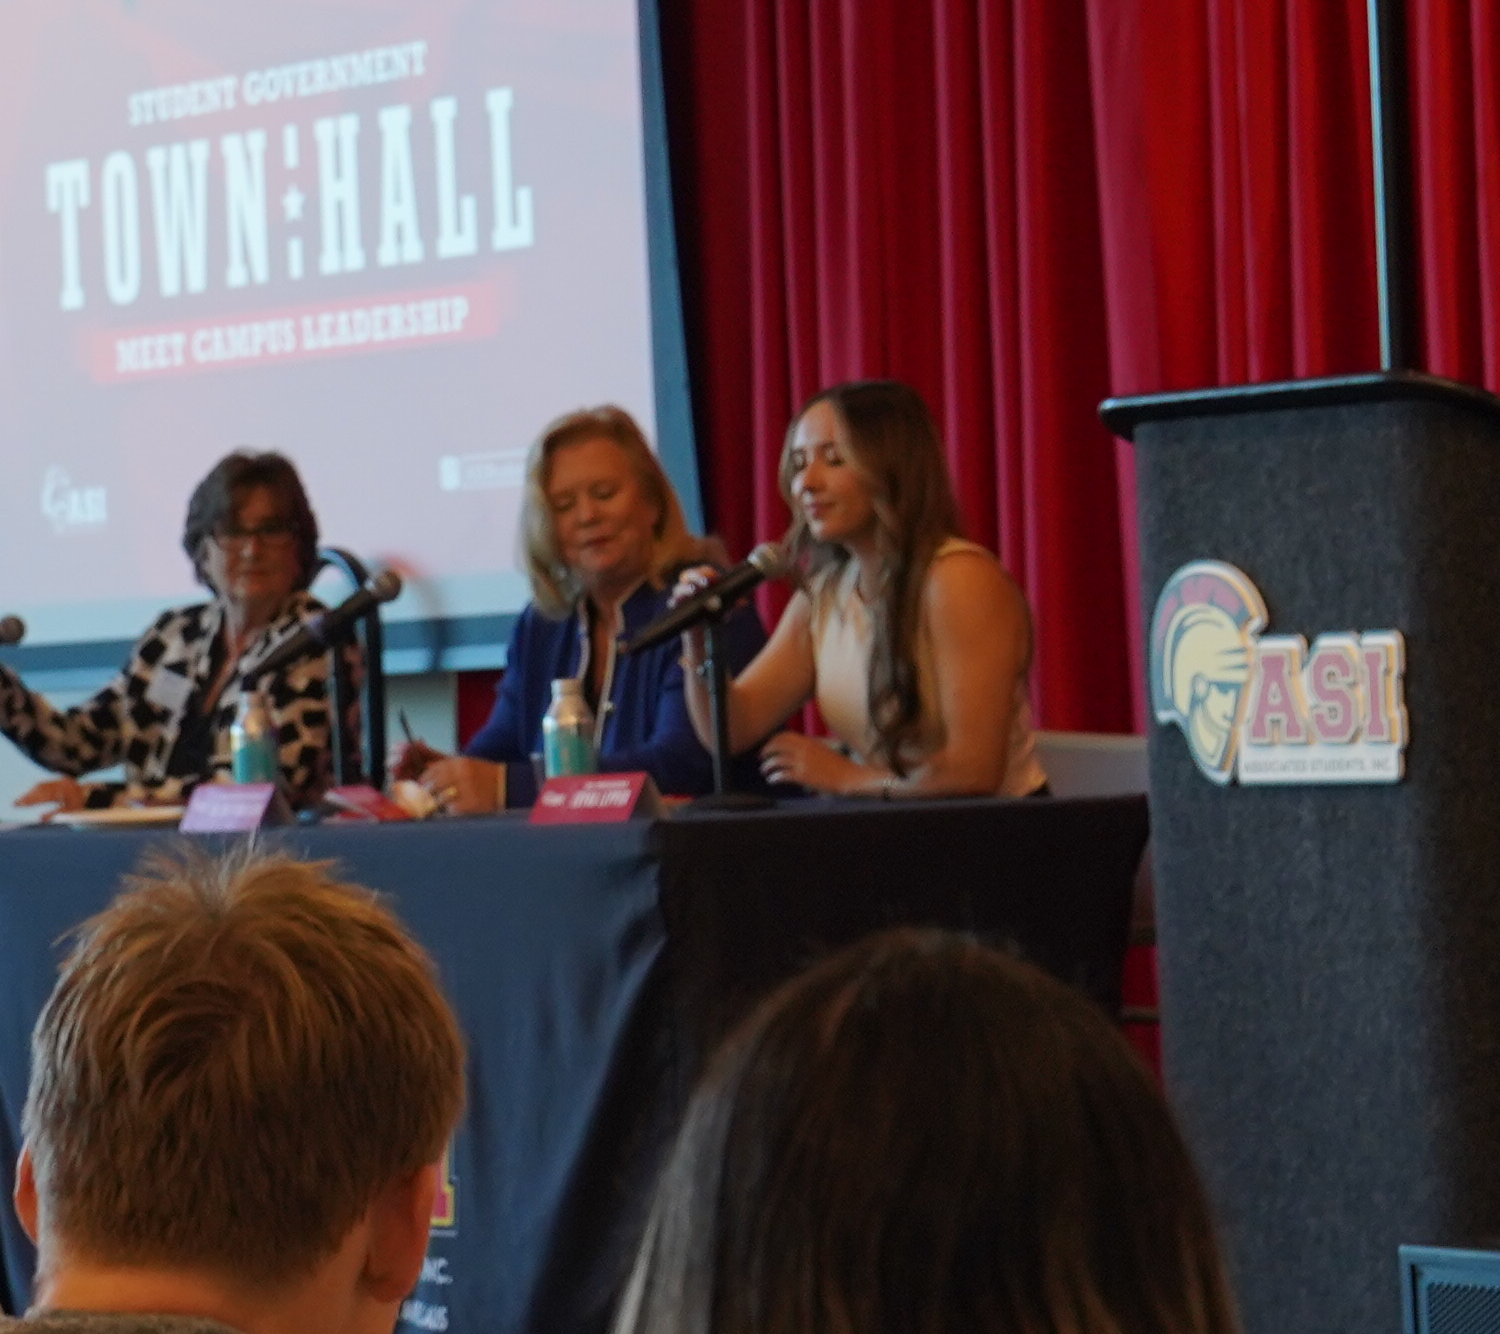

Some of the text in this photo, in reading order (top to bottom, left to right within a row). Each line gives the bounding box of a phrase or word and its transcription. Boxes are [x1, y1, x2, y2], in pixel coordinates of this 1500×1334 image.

[127, 39, 428, 127] STUDENT GOVERNMENT
[45, 86, 535, 311] TOWN HALL
[115, 295, 470, 373] MEET CAMPUS LEADERSHIP
[1247, 643, 1398, 746] ASI
